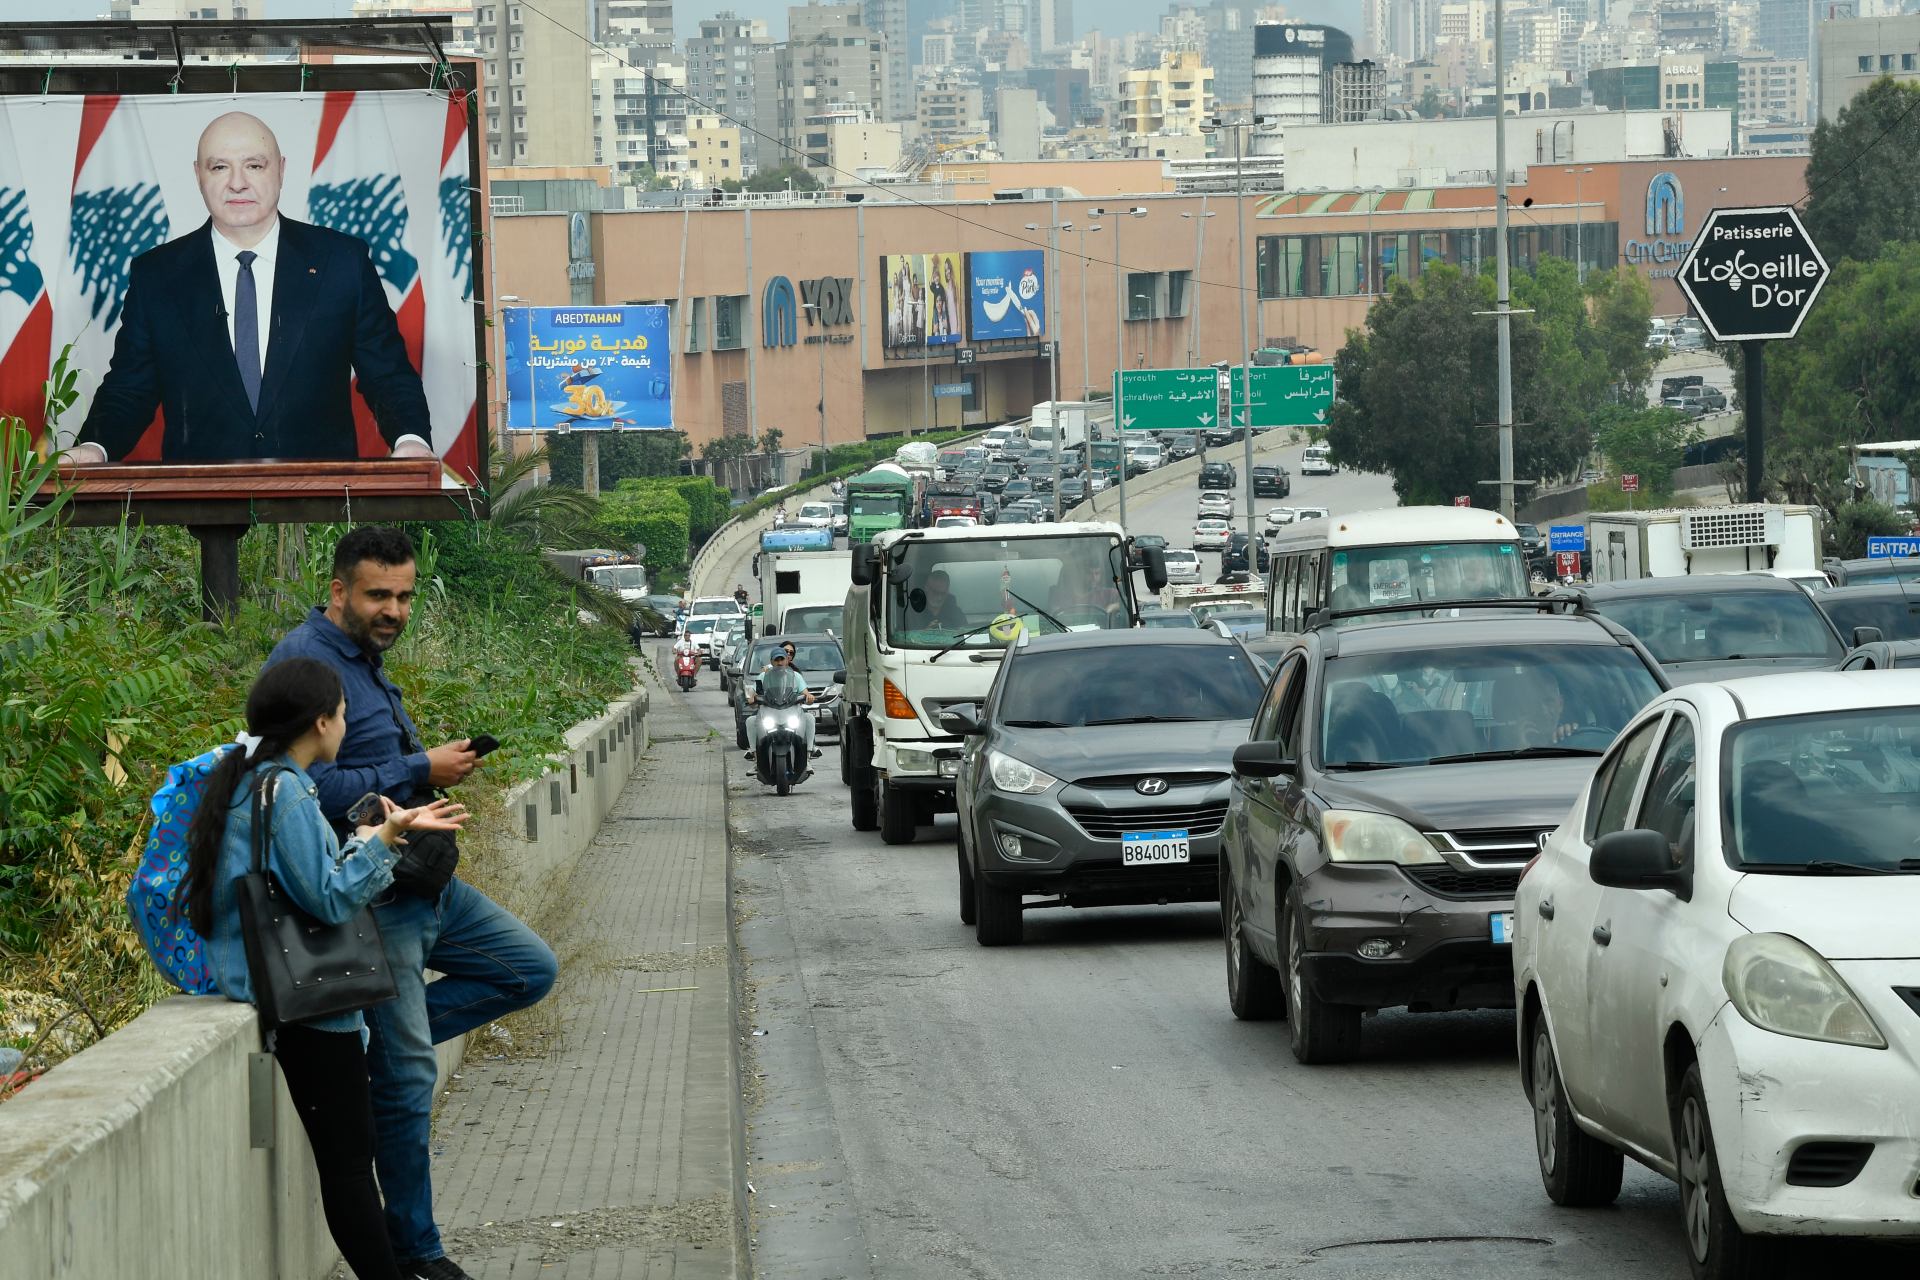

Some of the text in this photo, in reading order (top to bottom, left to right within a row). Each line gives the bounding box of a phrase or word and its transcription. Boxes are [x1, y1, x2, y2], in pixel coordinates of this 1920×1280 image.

[1665, 64, 1699, 75] ABRAJ
[1713, 223, 1793, 241] Patisserie
[799, 276, 855, 326] VOX
[1752, 283, 1807, 308] D'or
[555, 313, 621, 324] ABEDTAHAN
[580, 357, 597, 368] من
[1123, 373, 1156, 384] eyrouth
[1176, 372, 1214, 383] بيروت
[1123, 393, 1164, 402] chrafiyeh
[1234, 390, 1262, 399] Troli
[1284, 387, 1331, 399] طرابلس
[563, 385, 615, 417] 30%
[1871, 542, 1920, 554] ENTRA
[1124, 843, 1187, 862] B840015
